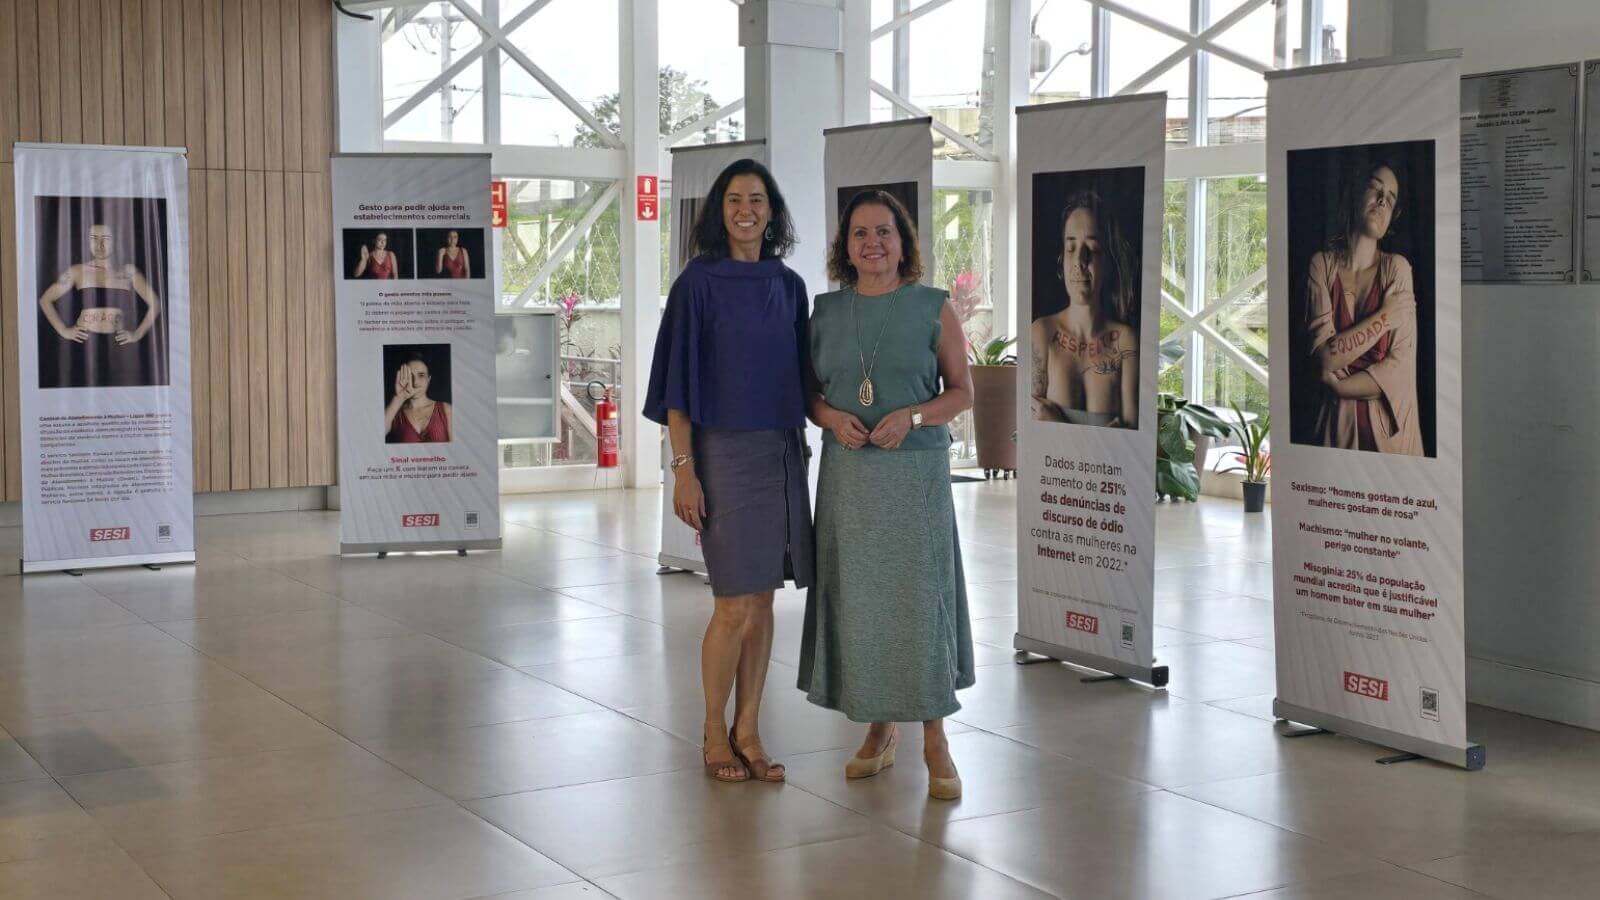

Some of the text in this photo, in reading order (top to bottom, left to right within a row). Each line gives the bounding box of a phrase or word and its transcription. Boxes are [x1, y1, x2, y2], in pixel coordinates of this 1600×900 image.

[1328, 313, 1390, 355] EQUIDADE
[1045, 455, 1122, 476] Dados apontam
[1040, 475, 1126, 496] aumento de 251%
[1291, 482, 1326, 495] Sexismo:
[1368, 492, 1400, 505] gostam
[1402, 496, 1414, 506] de
[1416, 498, 1438, 510] azul,
[1040, 491, 1125, 514] das denúncias de
[1308, 497, 1345, 510] mulheres
[1348, 503, 1379, 515] gostam
[1382, 506, 1392, 516] de
[406, 515, 436, 526] SESI
[1042, 510, 1123, 534] discurso de ódio
[94, 529, 126, 540] SESI
[1031, 527, 1136, 555] contra as mulheres na
[1299, 522, 1342, 537] Machismo:
[1381, 535, 1391, 544] no
[1393, 536, 1429, 551] volante,
[1037, 544, 1075, 562] Internet
[1079, 554, 1093, 566] em
[1325, 540, 1352, 553] perigo
[1304, 562, 1425, 592] Misoginia: 25% da população
[1294, 574, 1437, 608] mundial acredita que é justificável
[1296, 588, 1308, 598] um
[1310, 589, 1340, 603] homem
[1343, 595, 1365, 608] bater
[1367, 601, 1381, 611] em
[1383, 603, 1397, 614] sua
[1069, 614, 1096, 632] SESI
[1348, 676, 1384, 697] SESI
